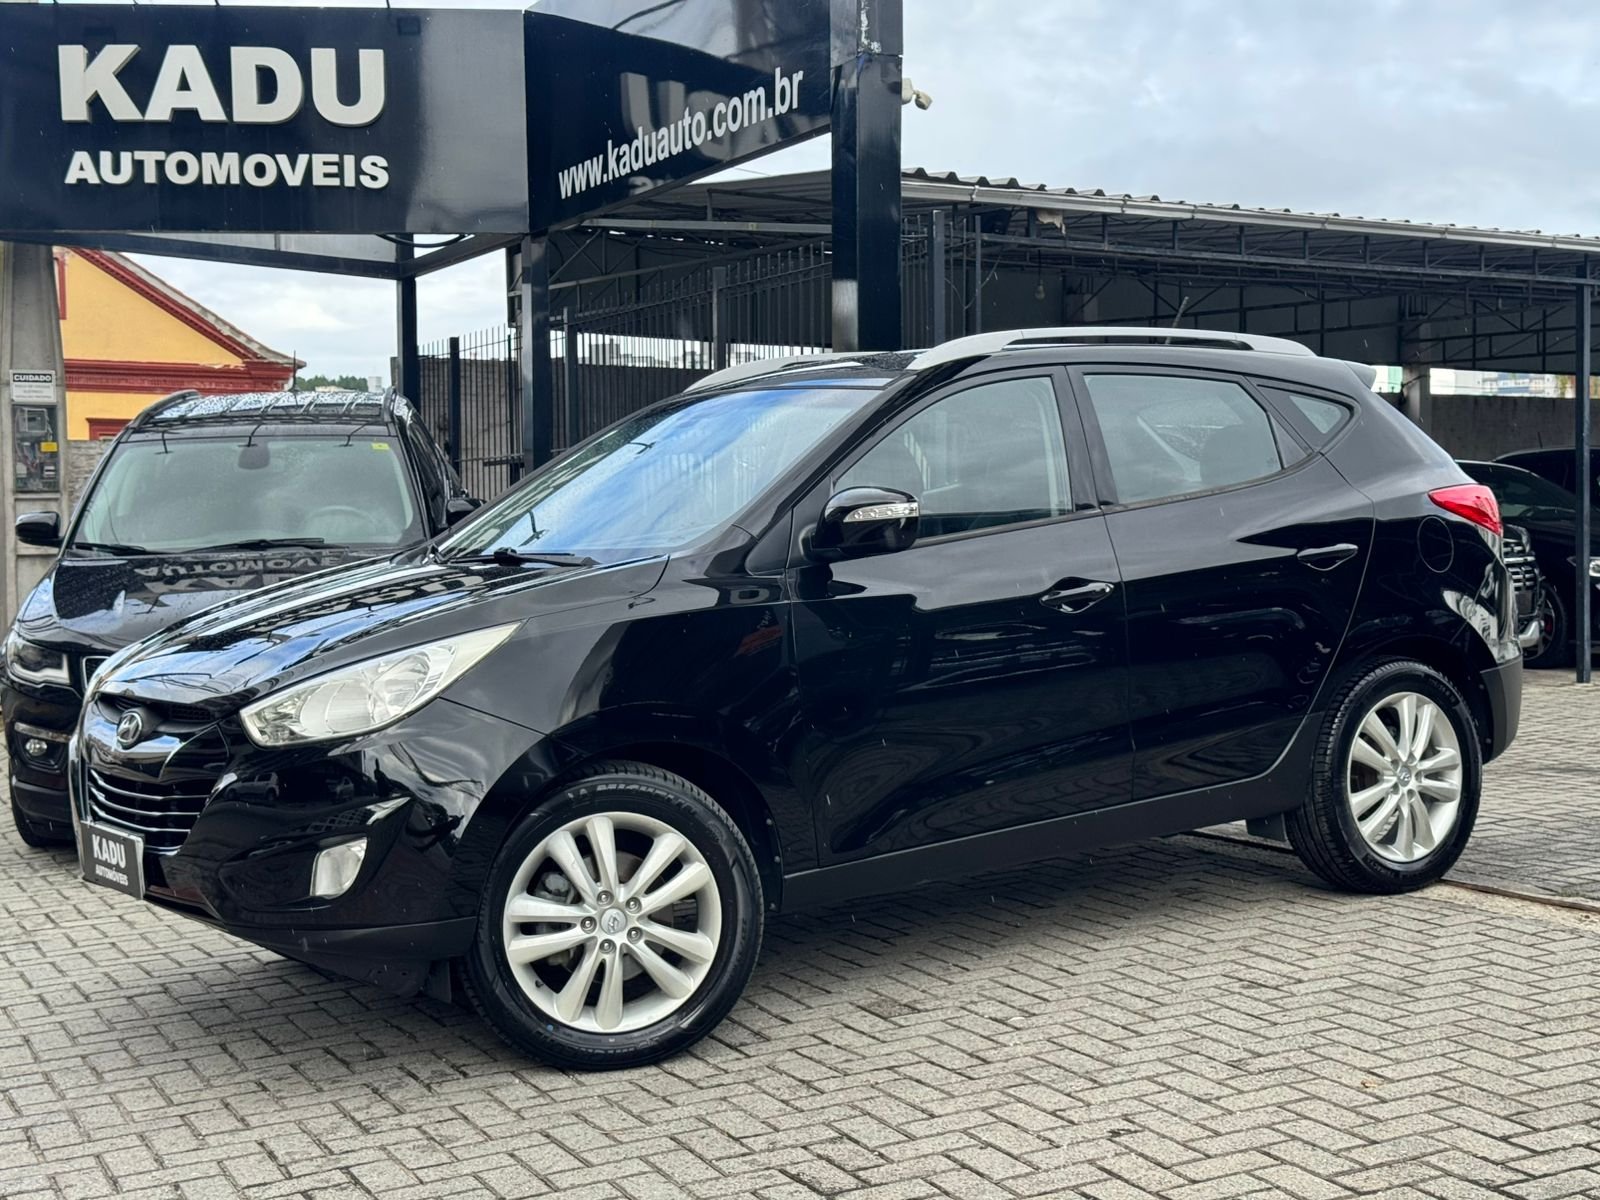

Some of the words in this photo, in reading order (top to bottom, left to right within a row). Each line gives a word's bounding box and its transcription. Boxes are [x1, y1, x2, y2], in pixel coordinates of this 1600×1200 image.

[58, 44, 386, 128] KADU
[558, 66, 804, 200] www.kaduauto.com.br
[64, 150, 391, 190] AUTOMOVEIS
[14, 374, 52, 382] CUIDADO
[92, 833, 127, 869] KADU
